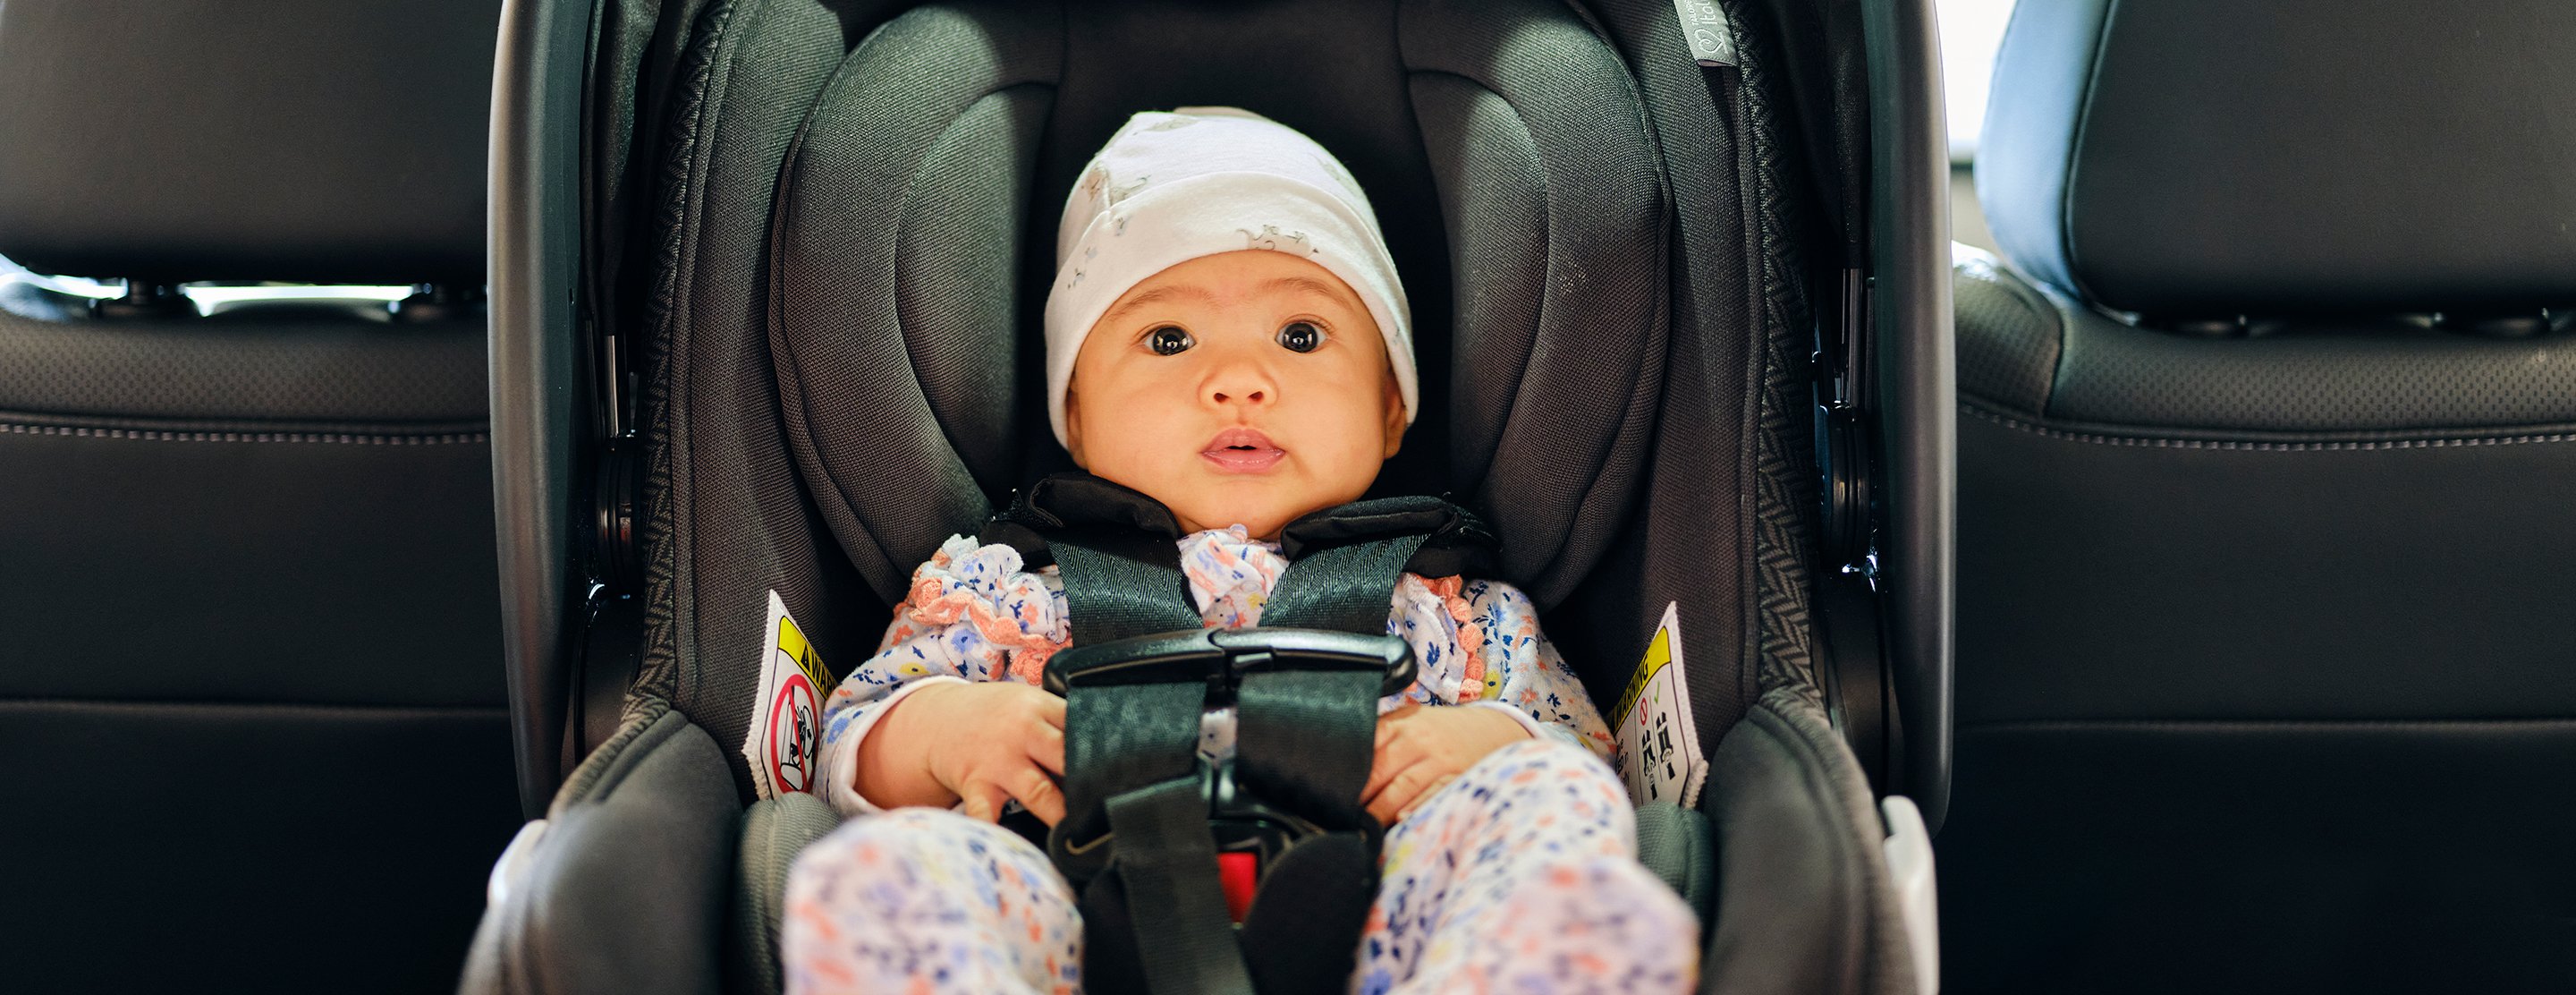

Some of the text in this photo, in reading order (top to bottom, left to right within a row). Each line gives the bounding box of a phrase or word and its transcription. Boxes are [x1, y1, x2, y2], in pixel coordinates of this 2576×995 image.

[1694, 0, 1718, 24] Ital
[810, 651, 836, 699] WAR
[1615, 653, 1648, 727] WARNING
